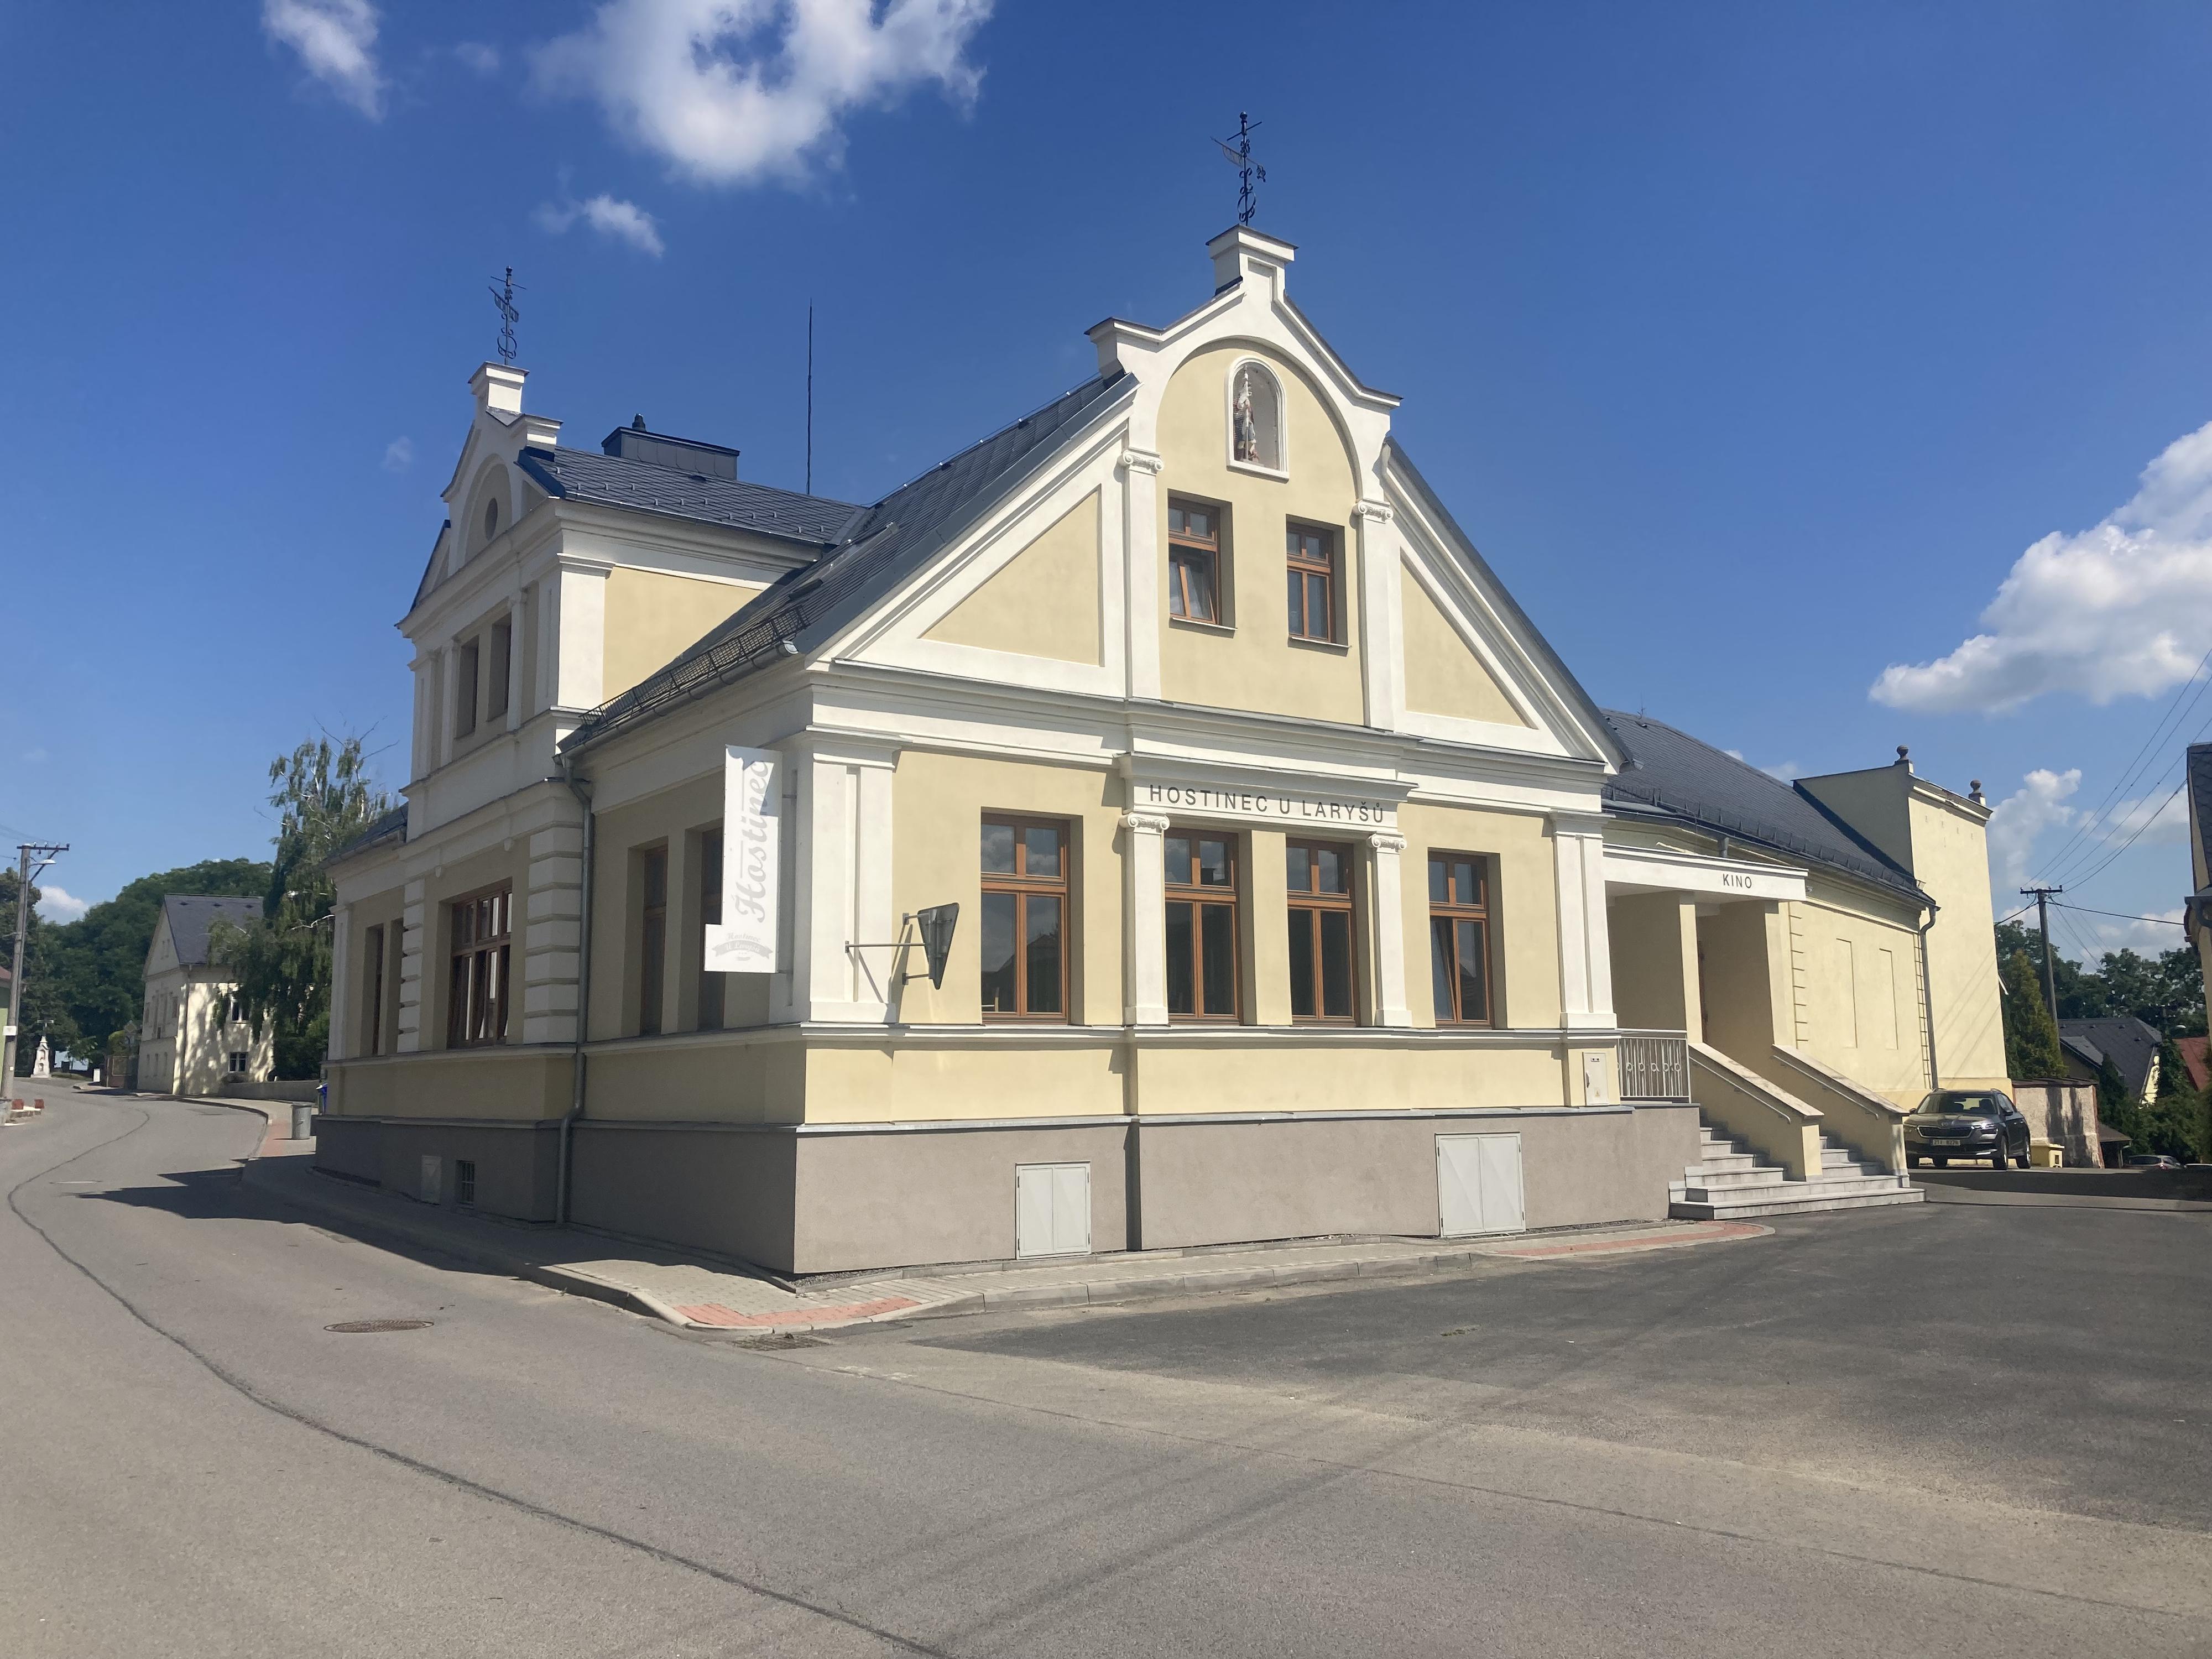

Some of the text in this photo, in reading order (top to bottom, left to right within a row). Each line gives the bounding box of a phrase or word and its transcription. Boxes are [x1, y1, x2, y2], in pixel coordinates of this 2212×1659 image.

[1150, 785, 1383, 823] HOSTINEC U LARYŠŮ
[735, 760, 769, 923] Hostinec
[1723, 873, 1752, 888] KINO
